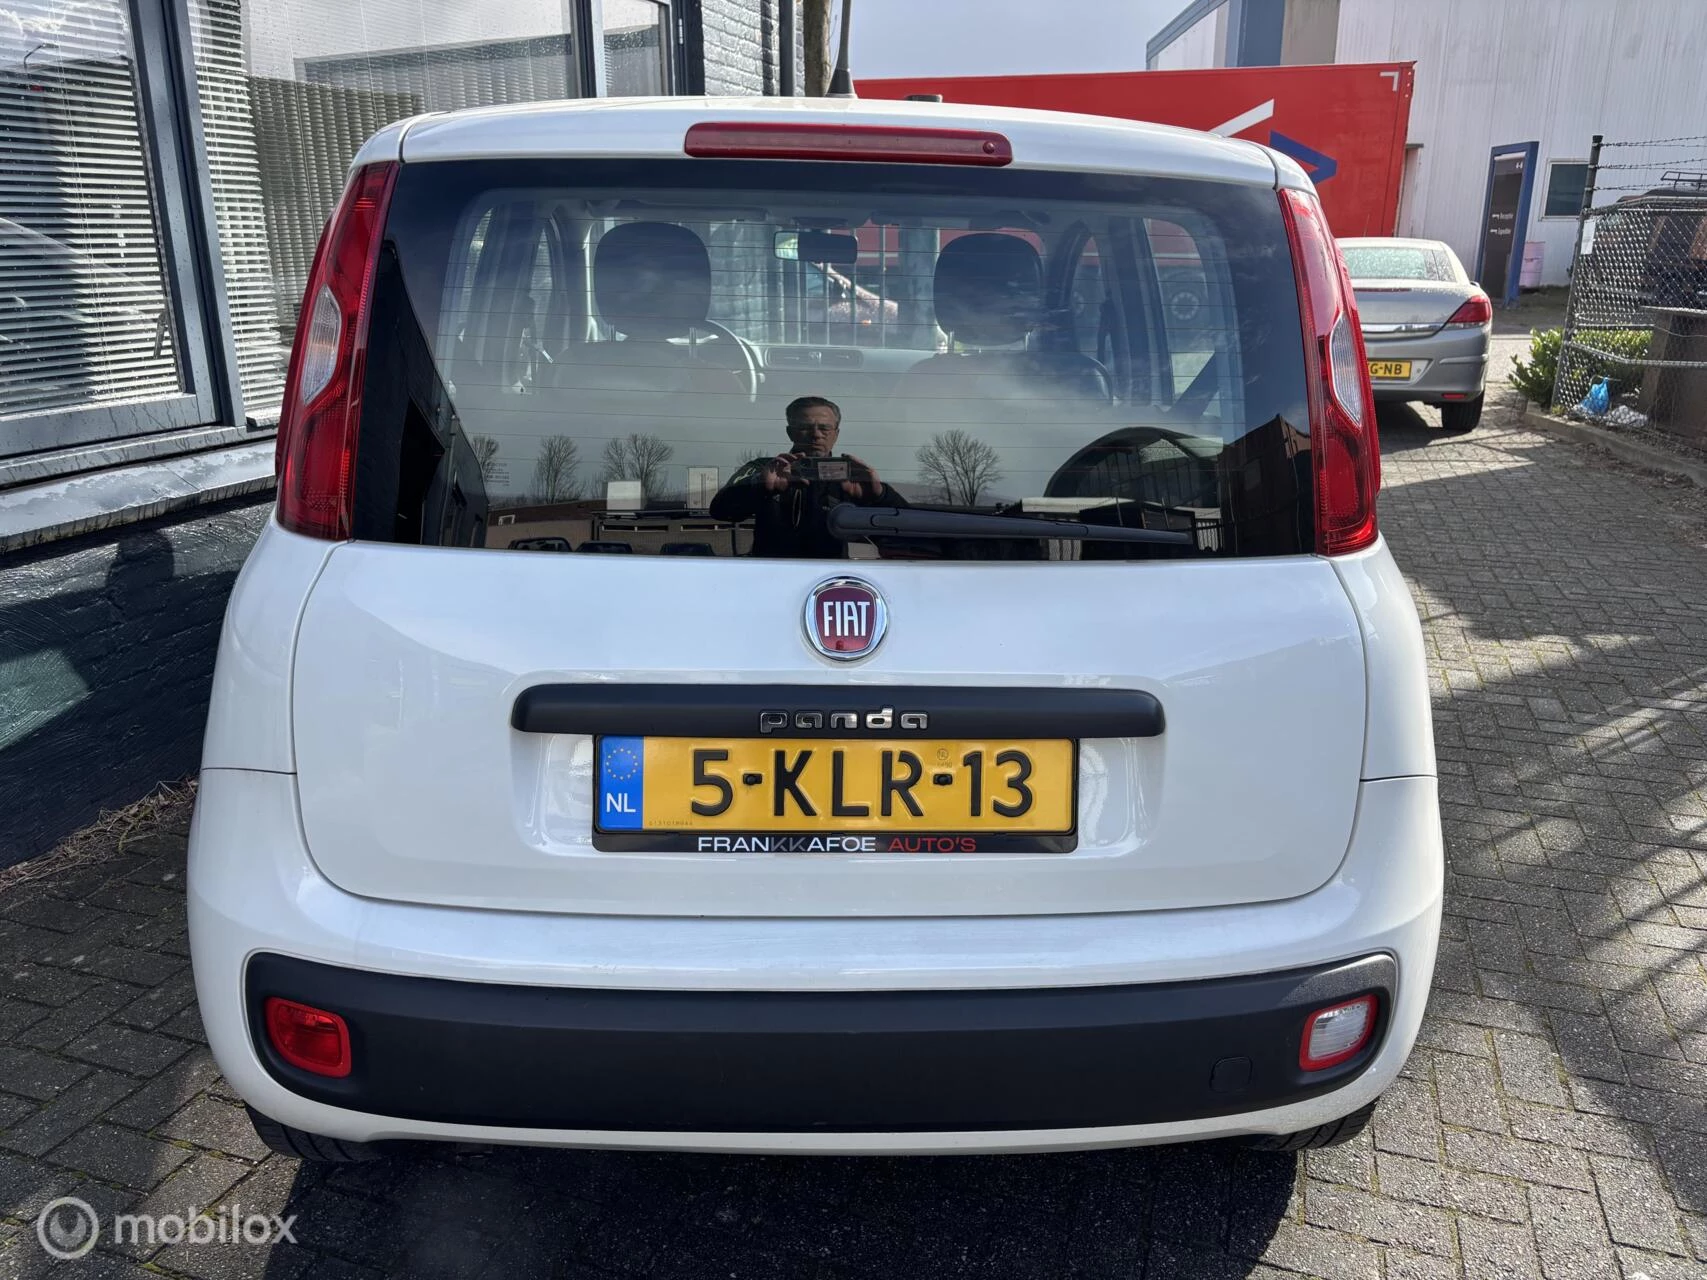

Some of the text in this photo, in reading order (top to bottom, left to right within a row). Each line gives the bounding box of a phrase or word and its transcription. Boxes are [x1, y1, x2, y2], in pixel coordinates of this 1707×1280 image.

[1367, 362, 1402, 375] G-NB
[823, 601, 871, 637] FIAT
[760, 707, 928, 734] panda
[690, 749, 1033, 818] 5-KLR-13
[605, 793, 636, 814] NL
[887, 837, 977, 852] AUTO'S
